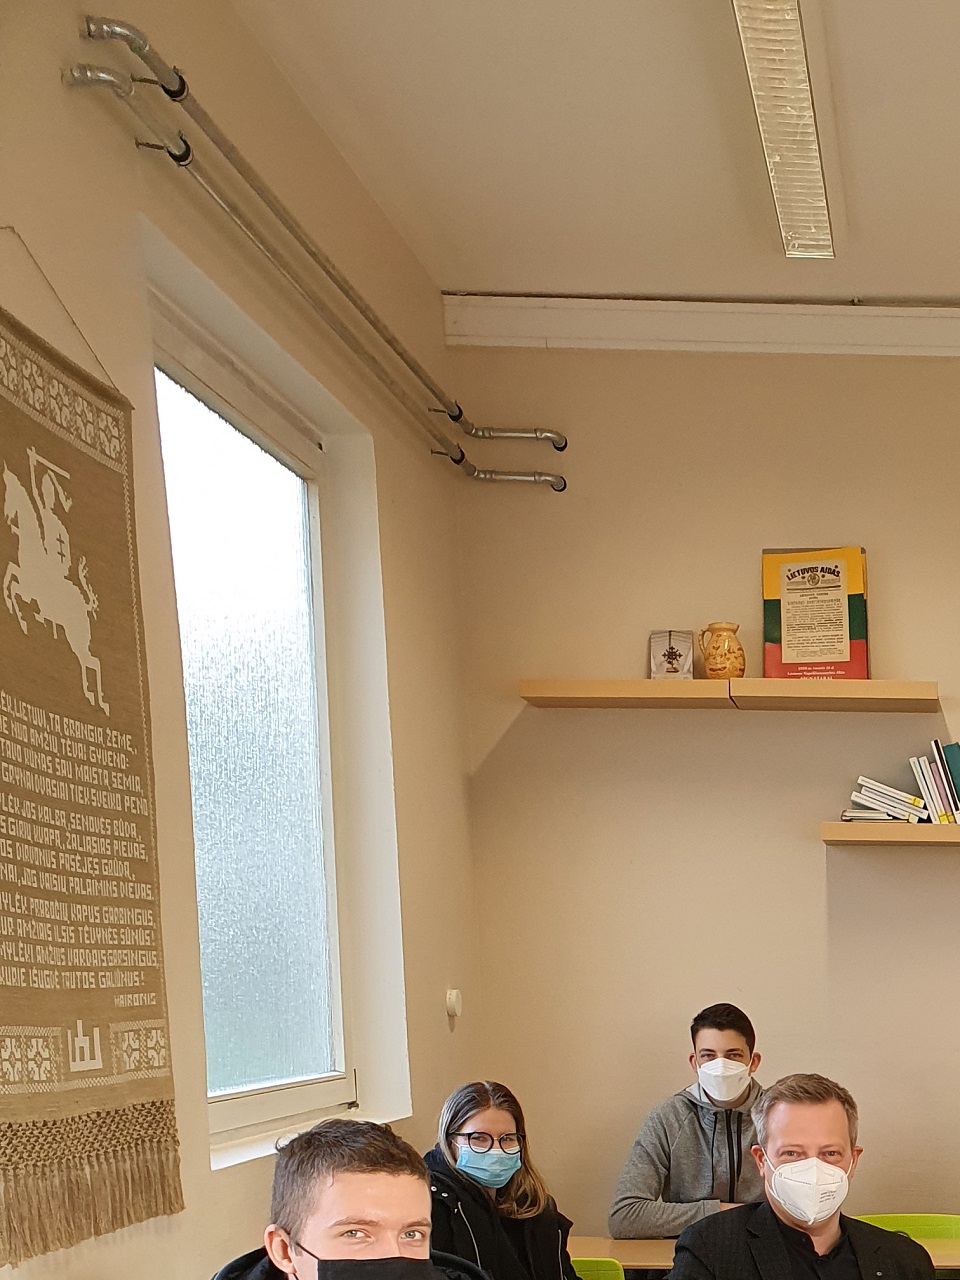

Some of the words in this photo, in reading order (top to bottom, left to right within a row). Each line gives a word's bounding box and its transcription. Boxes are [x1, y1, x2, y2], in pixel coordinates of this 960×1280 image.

[786, 566, 819, 581] LIETUVOS
[820, 566, 841, 578] AIDAS
[55, 757, 73, 779] SAU
[124, 795, 148, 816] PENO
[70, 903, 101, 923] KAPUS
